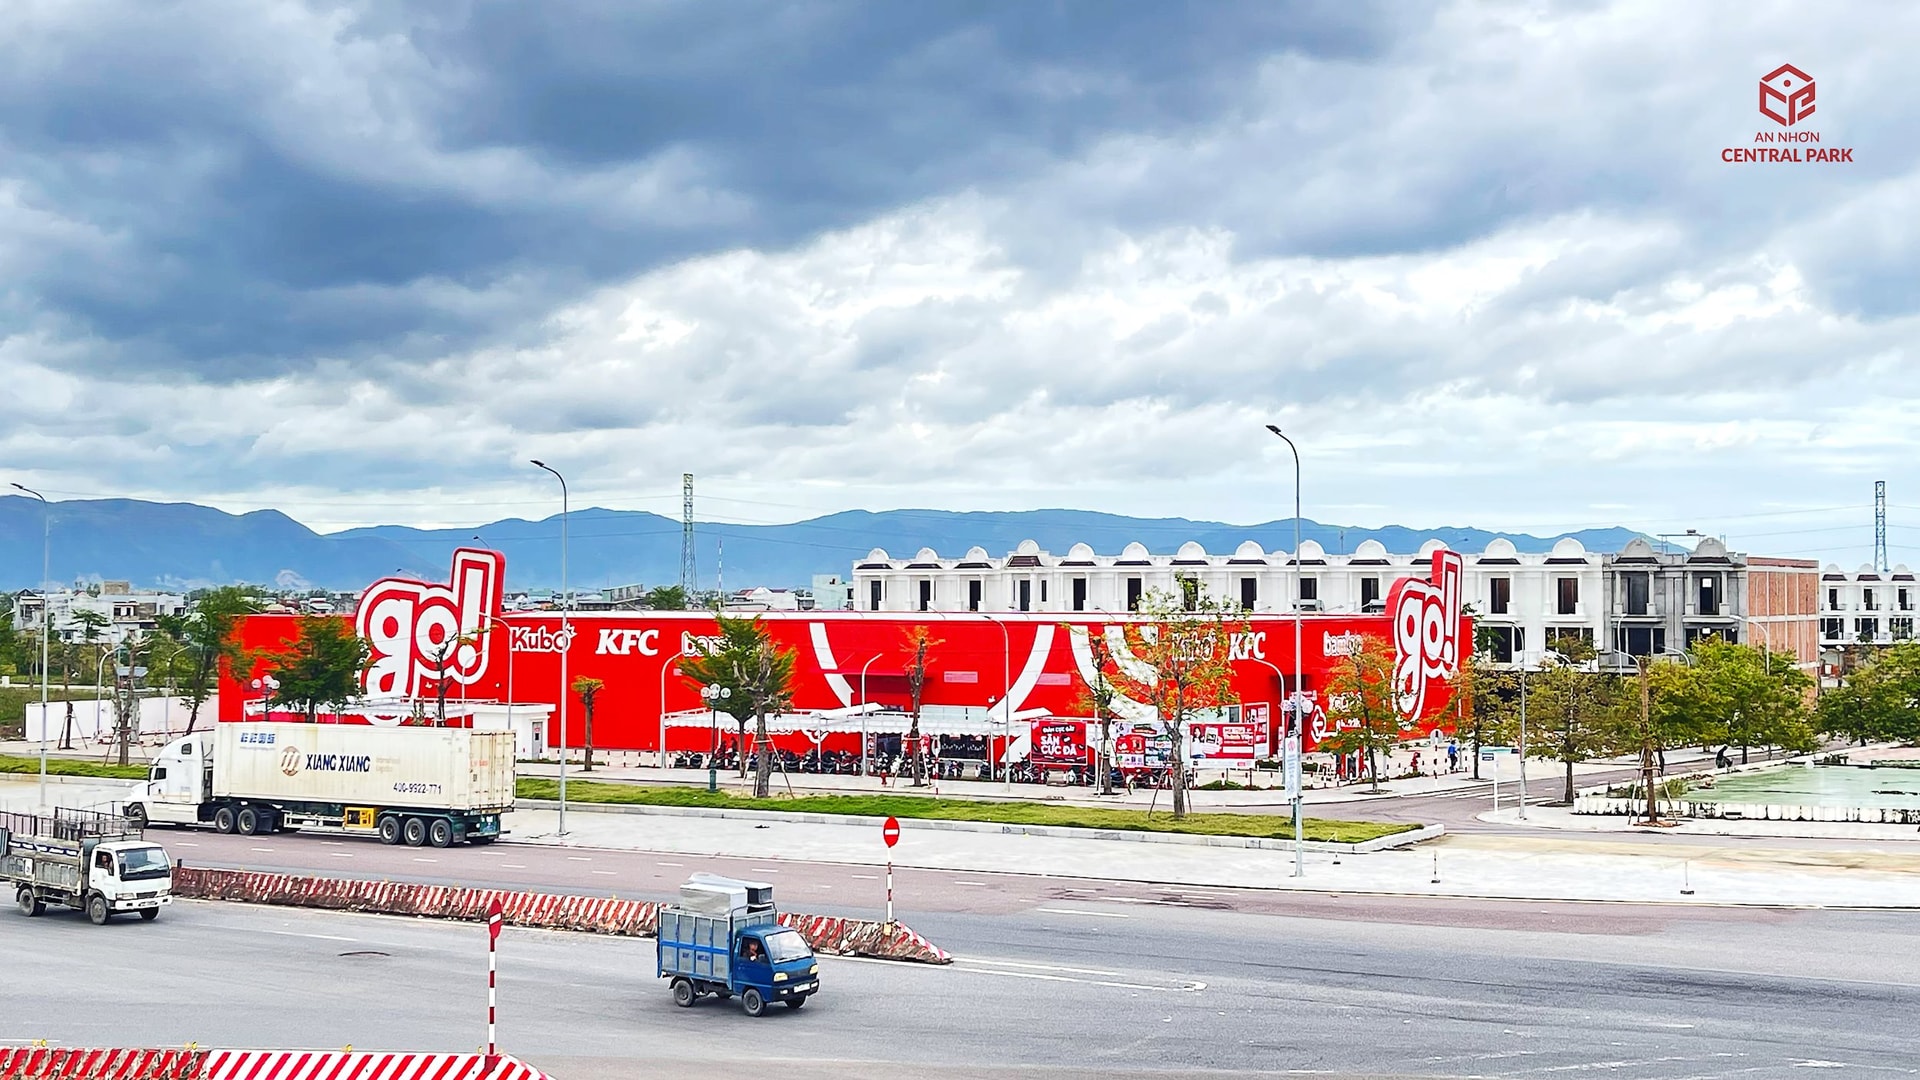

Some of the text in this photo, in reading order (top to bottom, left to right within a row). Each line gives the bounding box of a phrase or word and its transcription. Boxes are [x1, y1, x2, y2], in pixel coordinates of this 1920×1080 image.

[358, 553, 494, 725] go!
[595, 629, 659, 656] KFC
[1228, 631, 1266, 660] KFC
[1394, 555, 1462, 724] go!
[305, 754, 371, 773] XIANG XIANG
